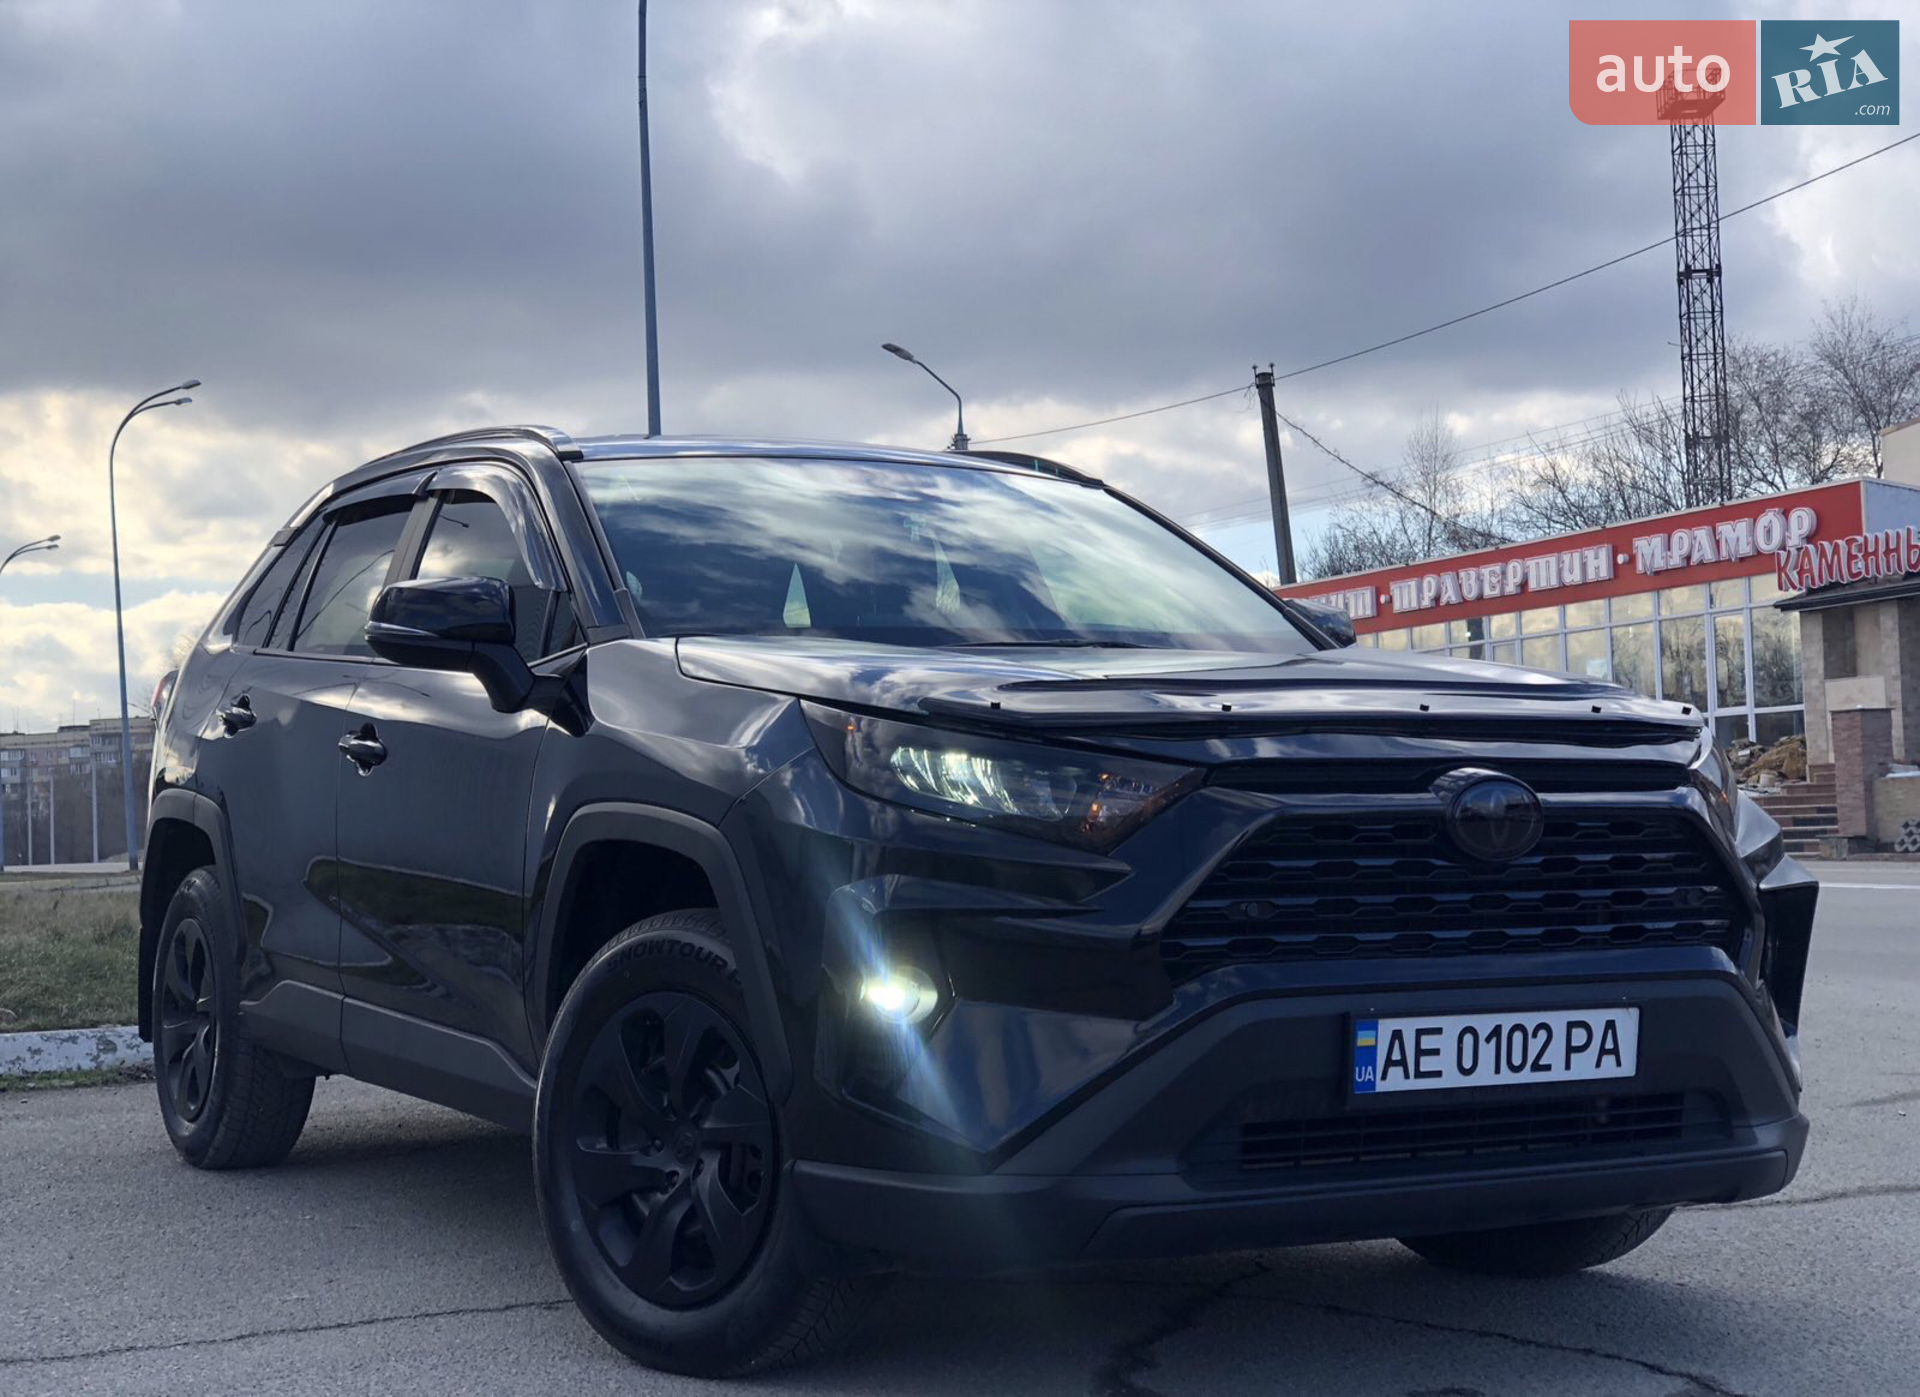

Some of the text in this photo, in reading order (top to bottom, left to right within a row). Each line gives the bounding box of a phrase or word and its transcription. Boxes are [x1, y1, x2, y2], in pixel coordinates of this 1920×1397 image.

[1389, 543, 1614, 614] ТРАВЕРТИН
[1633, 507, 1817, 576] МРАМОР
[1355, 1066, 1375, 1082] UA
[1380, 1019, 1623, 1081] AE 0102 PA
